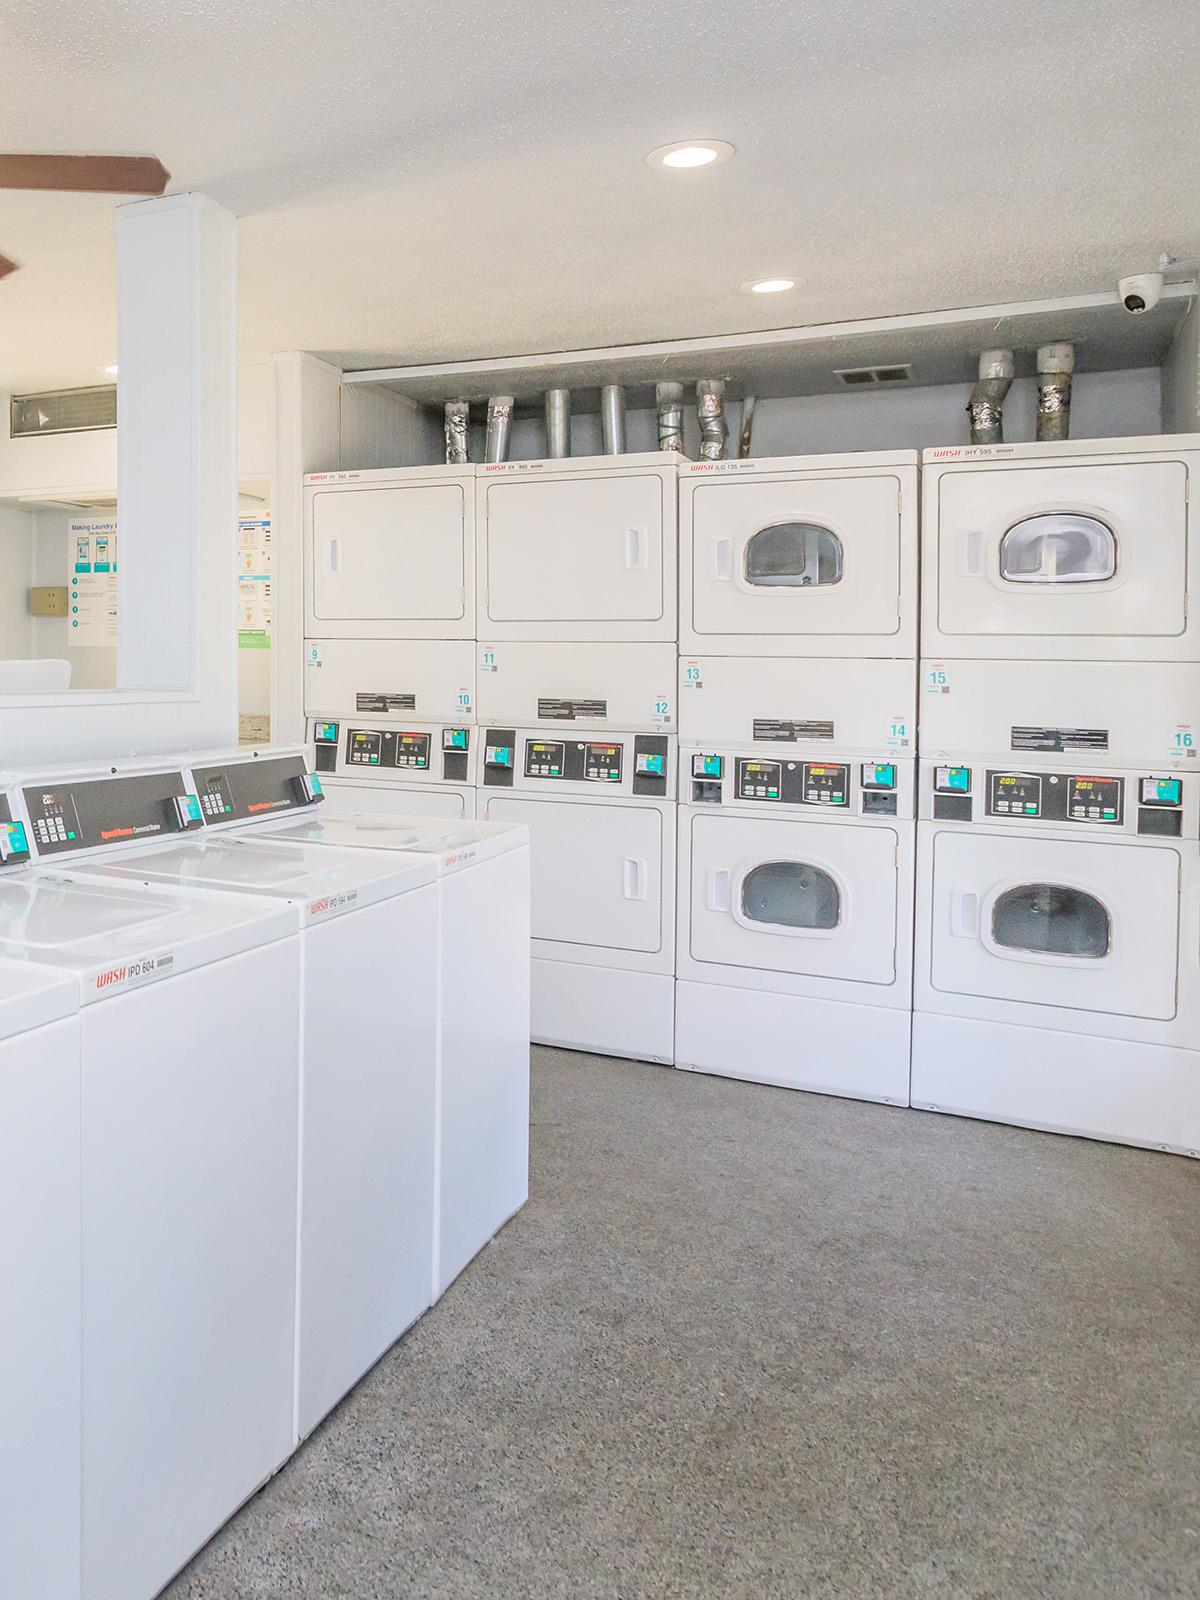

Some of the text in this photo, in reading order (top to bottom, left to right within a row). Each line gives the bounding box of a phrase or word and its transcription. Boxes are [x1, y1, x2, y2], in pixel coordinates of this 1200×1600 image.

[312, 649, 318, 660] 9
[484, 653, 494, 664] 11
[687, 668, 699, 680] 13
[930, 671, 946, 684] 15
[458, 694, 470, 705] 10
[655, 702, 668, 713] 12
[890, 724, 905, 736] 14
[1175, 733, 1192, 747] 16
[96, 960, 155, 988] WASH IPD 604
